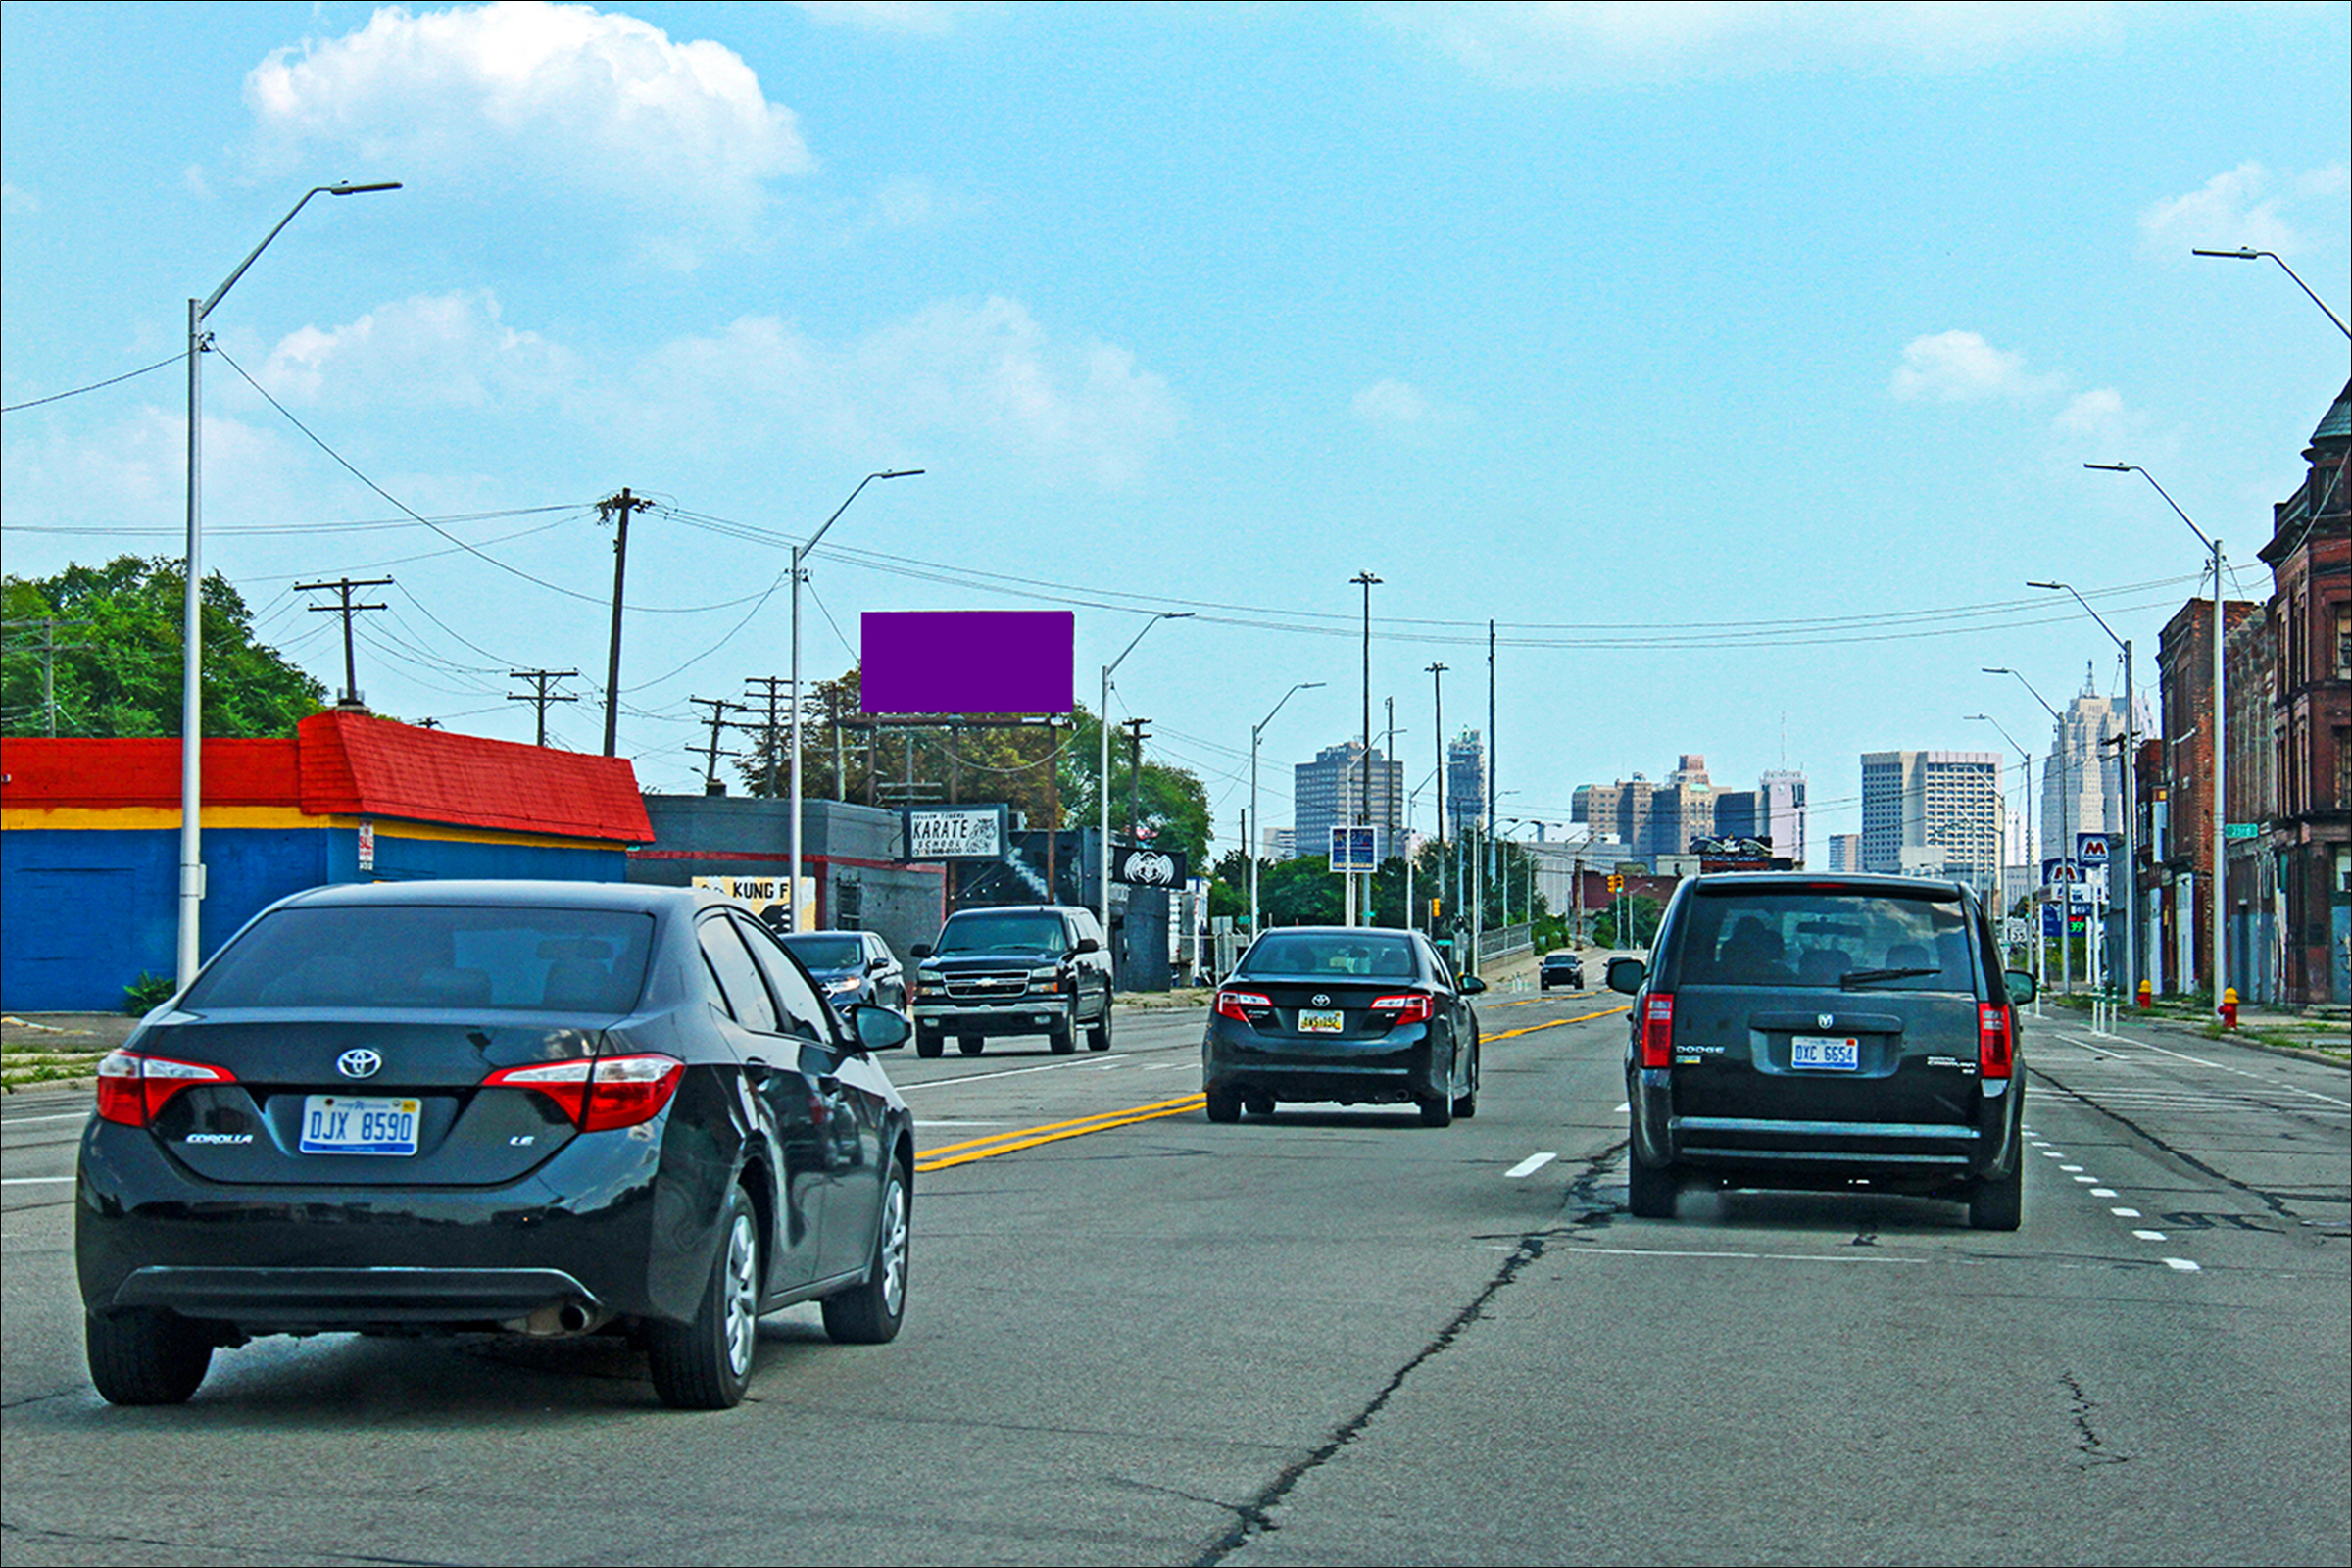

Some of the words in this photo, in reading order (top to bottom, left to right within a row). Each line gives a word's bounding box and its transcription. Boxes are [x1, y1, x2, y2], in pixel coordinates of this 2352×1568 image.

[912, 819, 969, 839] KARATE
[2084, 841, 2106, 855] M
[732, 882, 774, 899] KUNG
[779, 883, 790, 899] F
[1676, 1045, 1725, 1054] DODGE
[1795, 1044, 1818, 1061] DXC
[1824, 1045, 1853, 1062] 6654
[309, 1110, 350, 1140] DJX
[361, 1112, 413, 1142] 8590
[185, 1133, 254, 1145] COROLLA
[509, 1135, 535, 1146] LE
